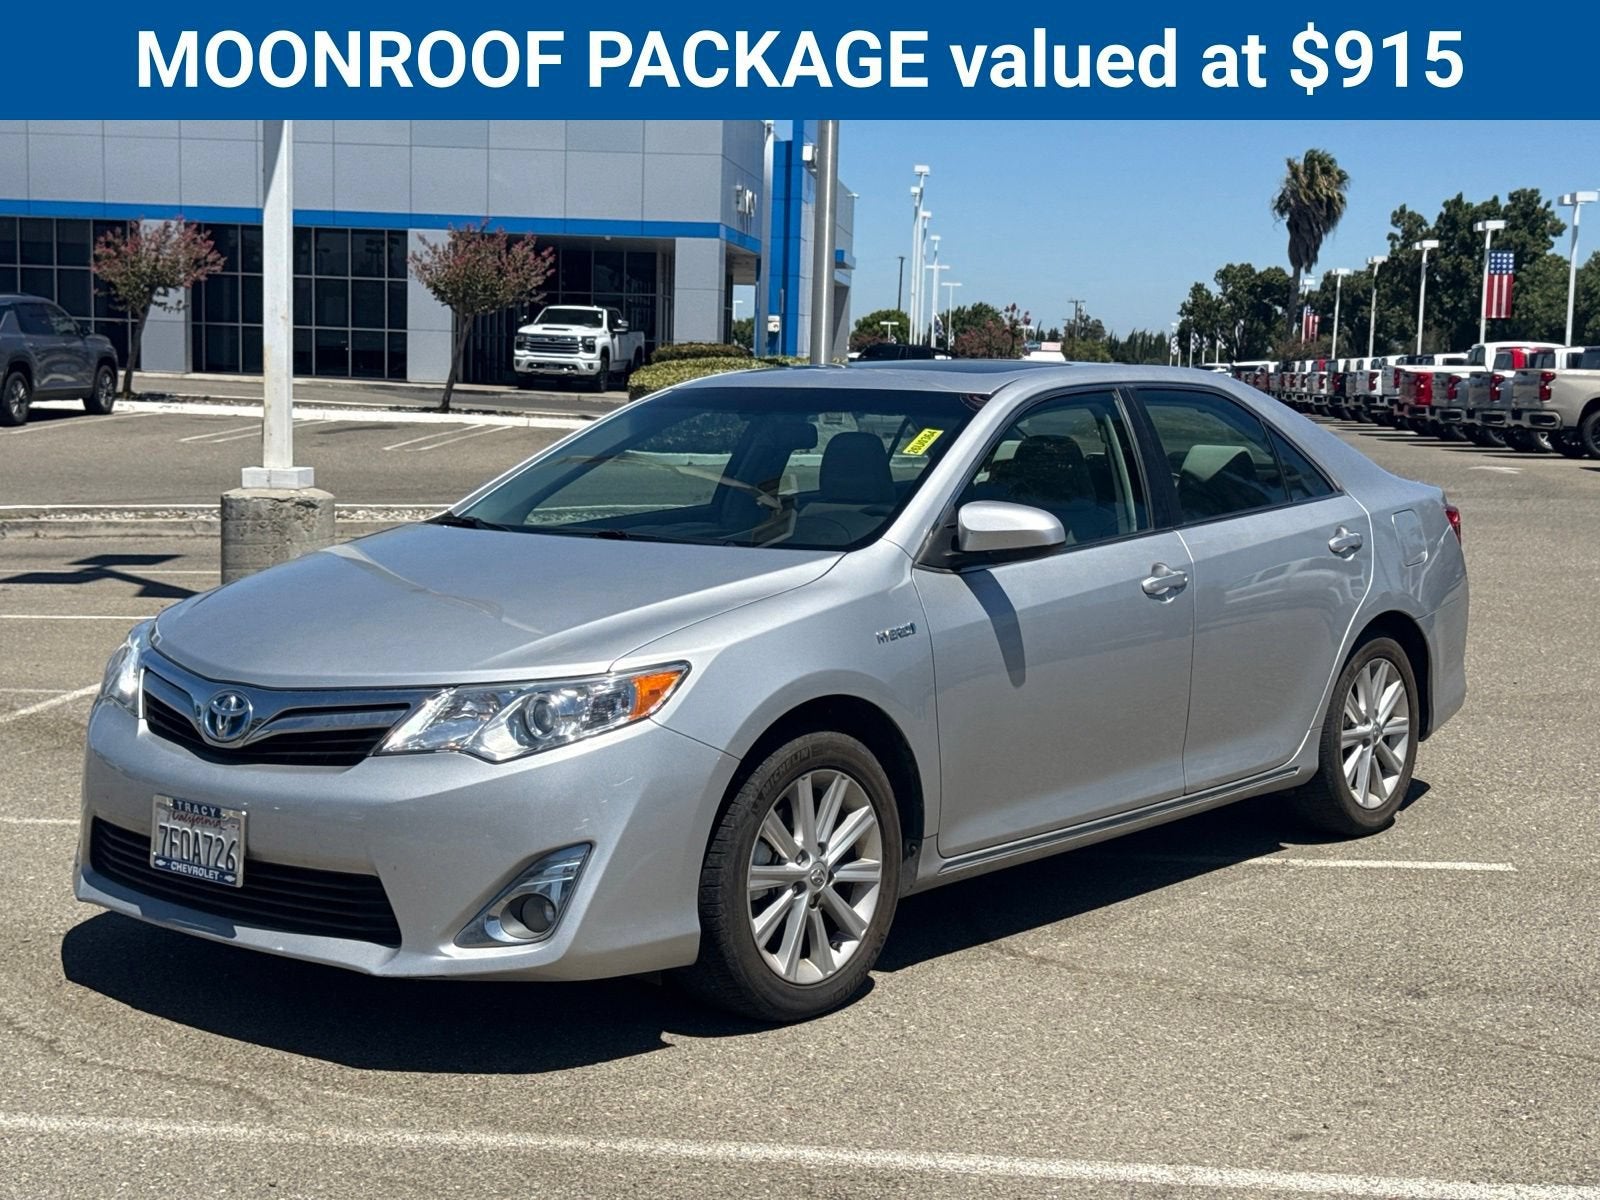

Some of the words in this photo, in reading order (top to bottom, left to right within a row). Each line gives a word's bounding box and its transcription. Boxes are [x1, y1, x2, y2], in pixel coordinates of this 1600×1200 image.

[876, 622, 916, 645] HYBRID
[760, 746, 810, 798] MICHELIN
[177, 801, 216, 817] TRACY
[171, 861, 220, 880] CHEVROLET
